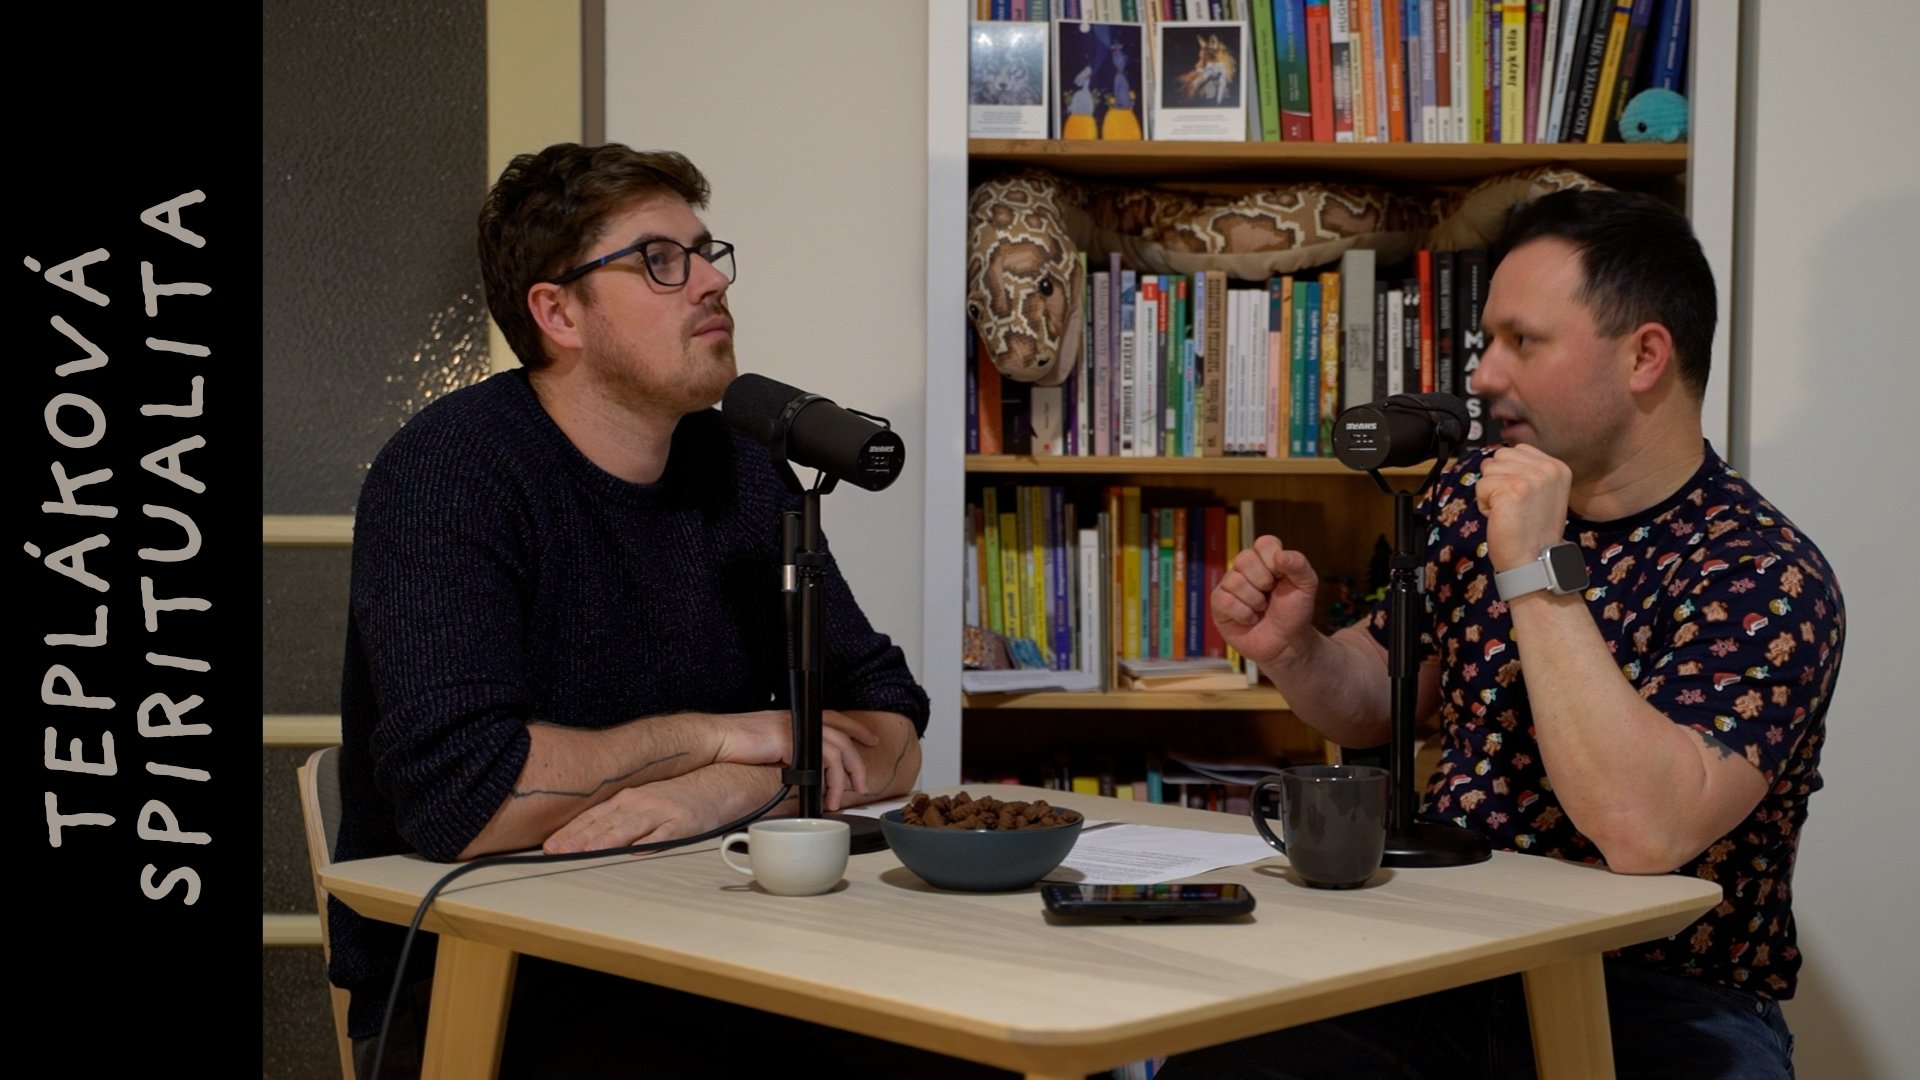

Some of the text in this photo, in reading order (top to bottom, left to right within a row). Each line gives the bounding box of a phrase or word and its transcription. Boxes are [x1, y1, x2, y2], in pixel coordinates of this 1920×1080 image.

[1506, 29, 1517, 51] těla
[1590, 32, 1605, 57] SÍTI
[1506, 56, 1518, 87] Jazyk
[1580, 68, 1598, 108] CHYTÁ
[1574, 108, 1588, 136] KDO
